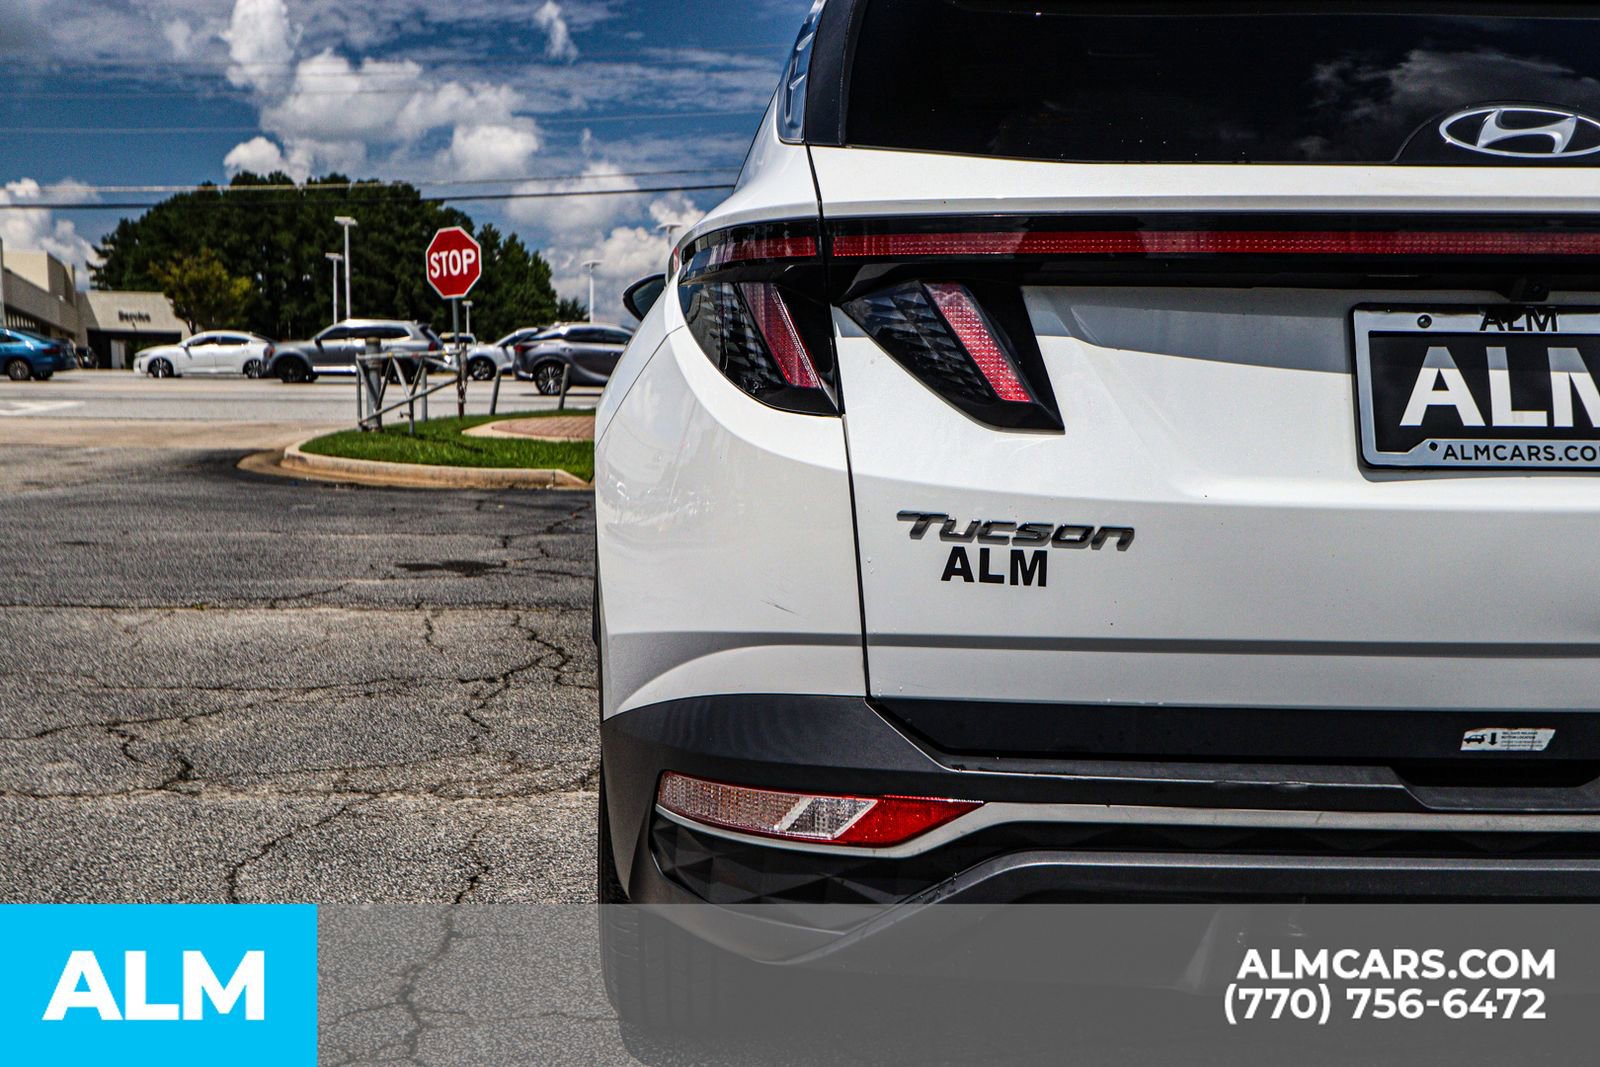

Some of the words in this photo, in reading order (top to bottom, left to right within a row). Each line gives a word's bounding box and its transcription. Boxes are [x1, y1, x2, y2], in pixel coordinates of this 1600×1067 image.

[430, 248, 476, 279] STOP
[1479, 306, 1559, 333] ALM
[1443, 445, 1600, 462] ALMCARS.CO
[941, 546, 1048, 587] ALM
